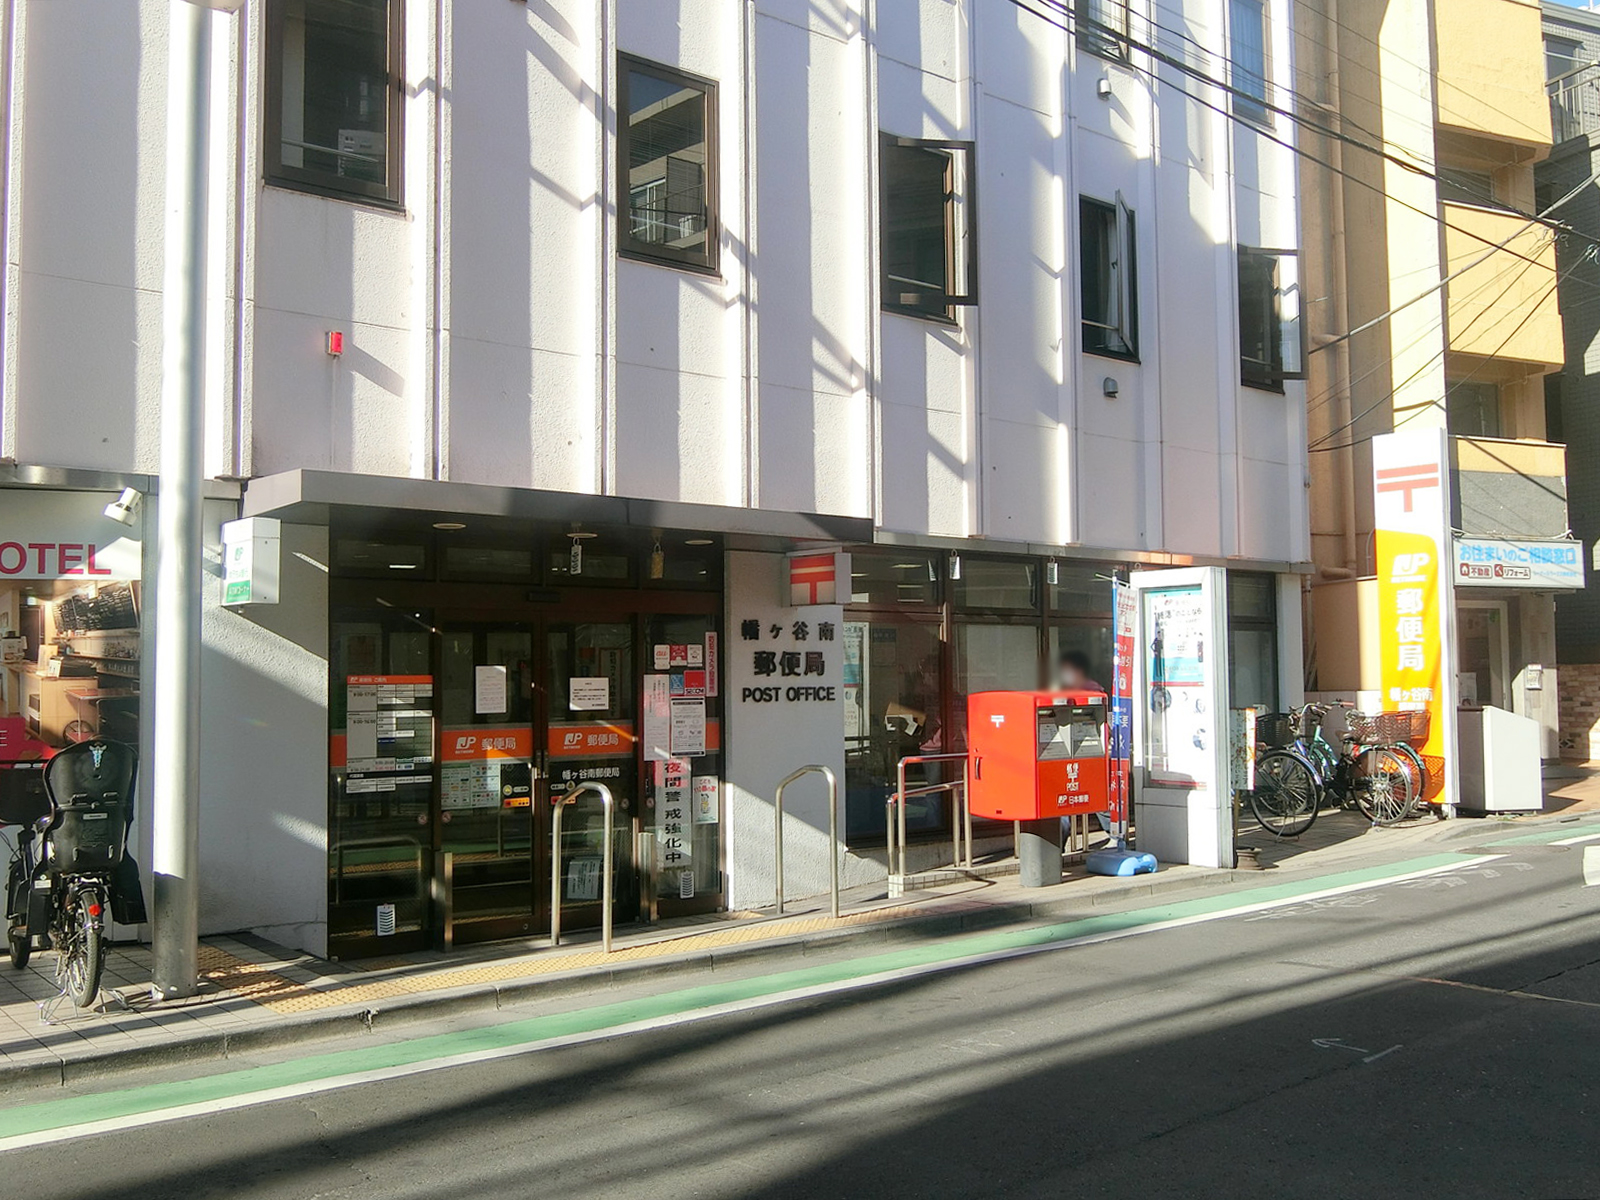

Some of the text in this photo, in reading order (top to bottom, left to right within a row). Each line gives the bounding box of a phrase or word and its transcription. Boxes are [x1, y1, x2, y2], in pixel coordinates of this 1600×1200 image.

[1459, 545, 1577, 565] お住まいのご相談窓口
[1471, 567, 1490, 576] 不動産
[1504, 568, 1529, 577] リフォーム
[1396, 588, 1424, 671] 郵便局
[753, 651, 825, 677] 郵便局
[742, 686, 836, 702] POST OFFICE
[481, 737, 516, 750] 郵便局
[587, 734, 619, 746] 郵便局
[1066, 782, 1079, 791] POST
[1069, 794, 1089, 805] 日本郵便
[664, 762, 682, 863] 夜間警戒強化中
